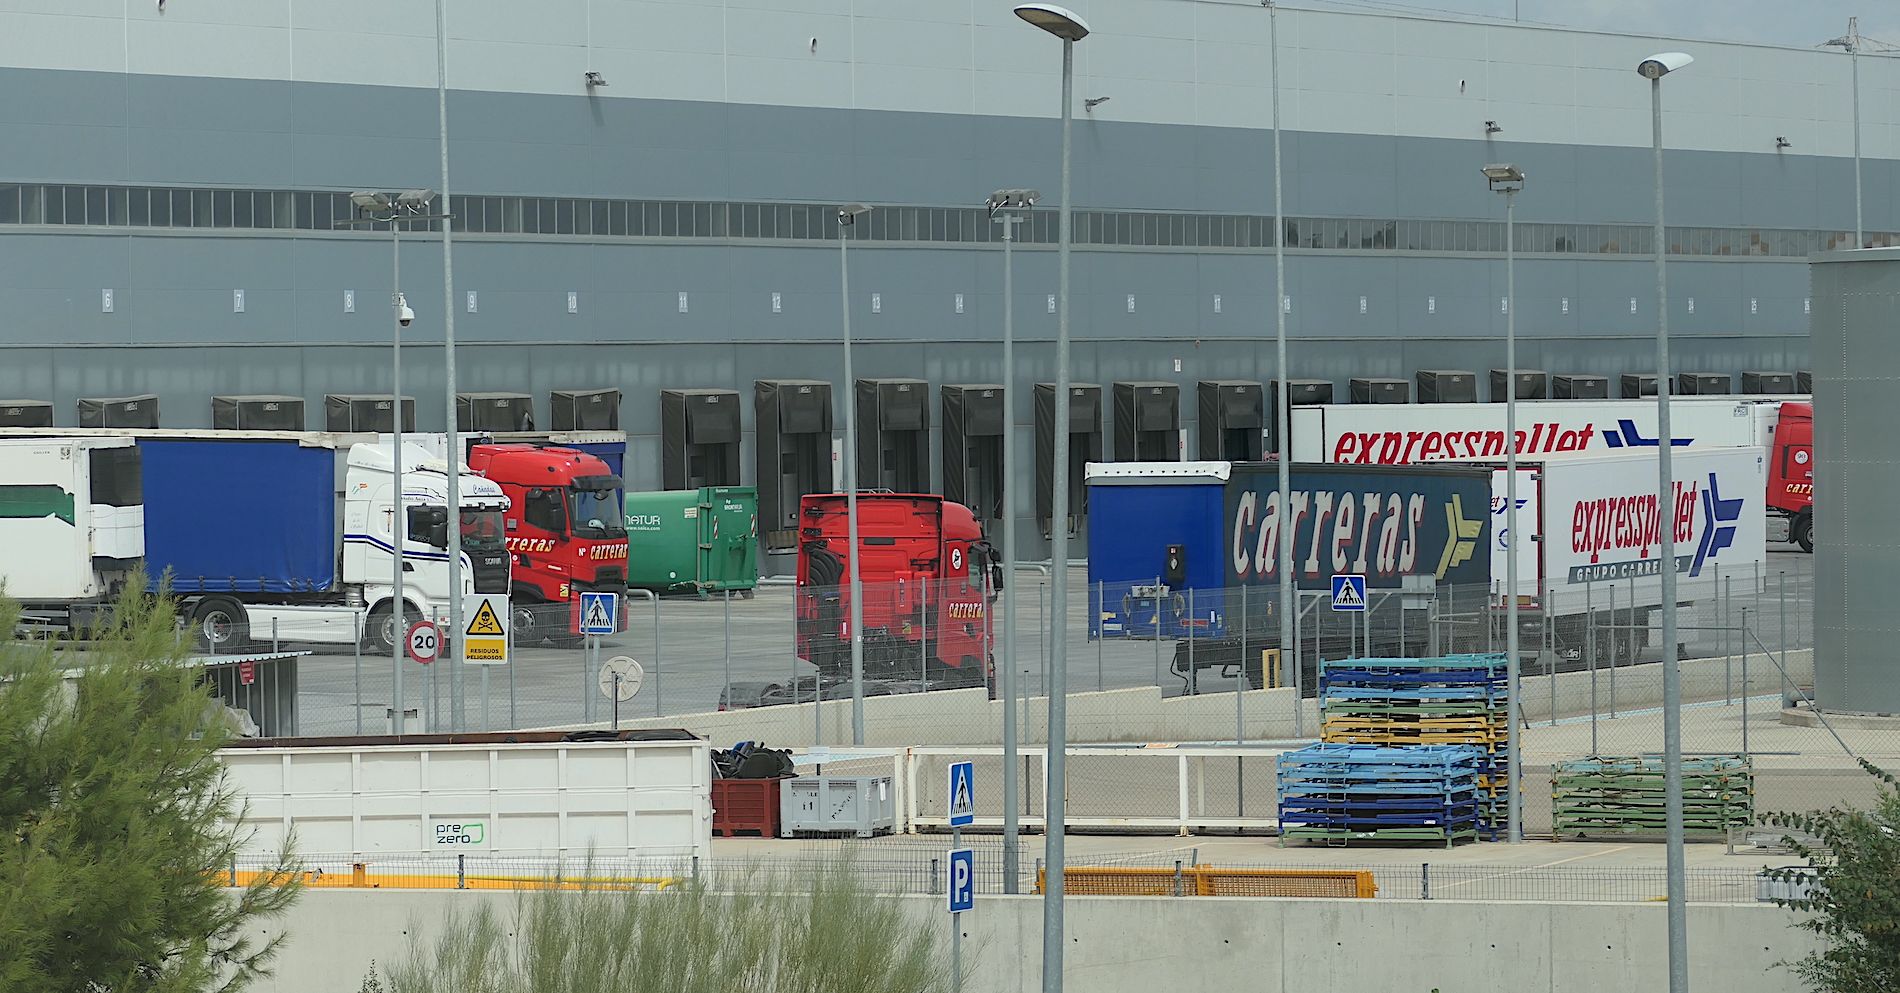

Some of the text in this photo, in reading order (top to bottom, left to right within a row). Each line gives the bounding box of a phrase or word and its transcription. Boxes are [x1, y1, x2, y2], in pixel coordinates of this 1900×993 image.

[105, 293, 111, 307] 6
[236, 294, 242, 307] 7
[346, 294, 352, 308] 8
[469, 294, 475, 308] 9
[567, 295, 577, 309] 10
[679, 295, 688, 308] 11
[772, 296, 781, 308] 12
[872, 297, 881, 309] 13
[955, 297, 964, 309] 14
[1048, 297, 1055, 309] 15
[1127, 297, 1135, 309] 16
[1572, 481, 1697, 564] expressplet
[1233, 490, 1425, 580] carreras
[590, 543, 628, 560] carreras
[1576, 559, 1680, 581] GRUPO CARRES
[949, 602, 985, 618] carrera
[415, 635, 436, 649] 20
[436, 824, 461, 836] pre
[437, 834, 471, 844] zero
[955, 859, 969, 903] P
